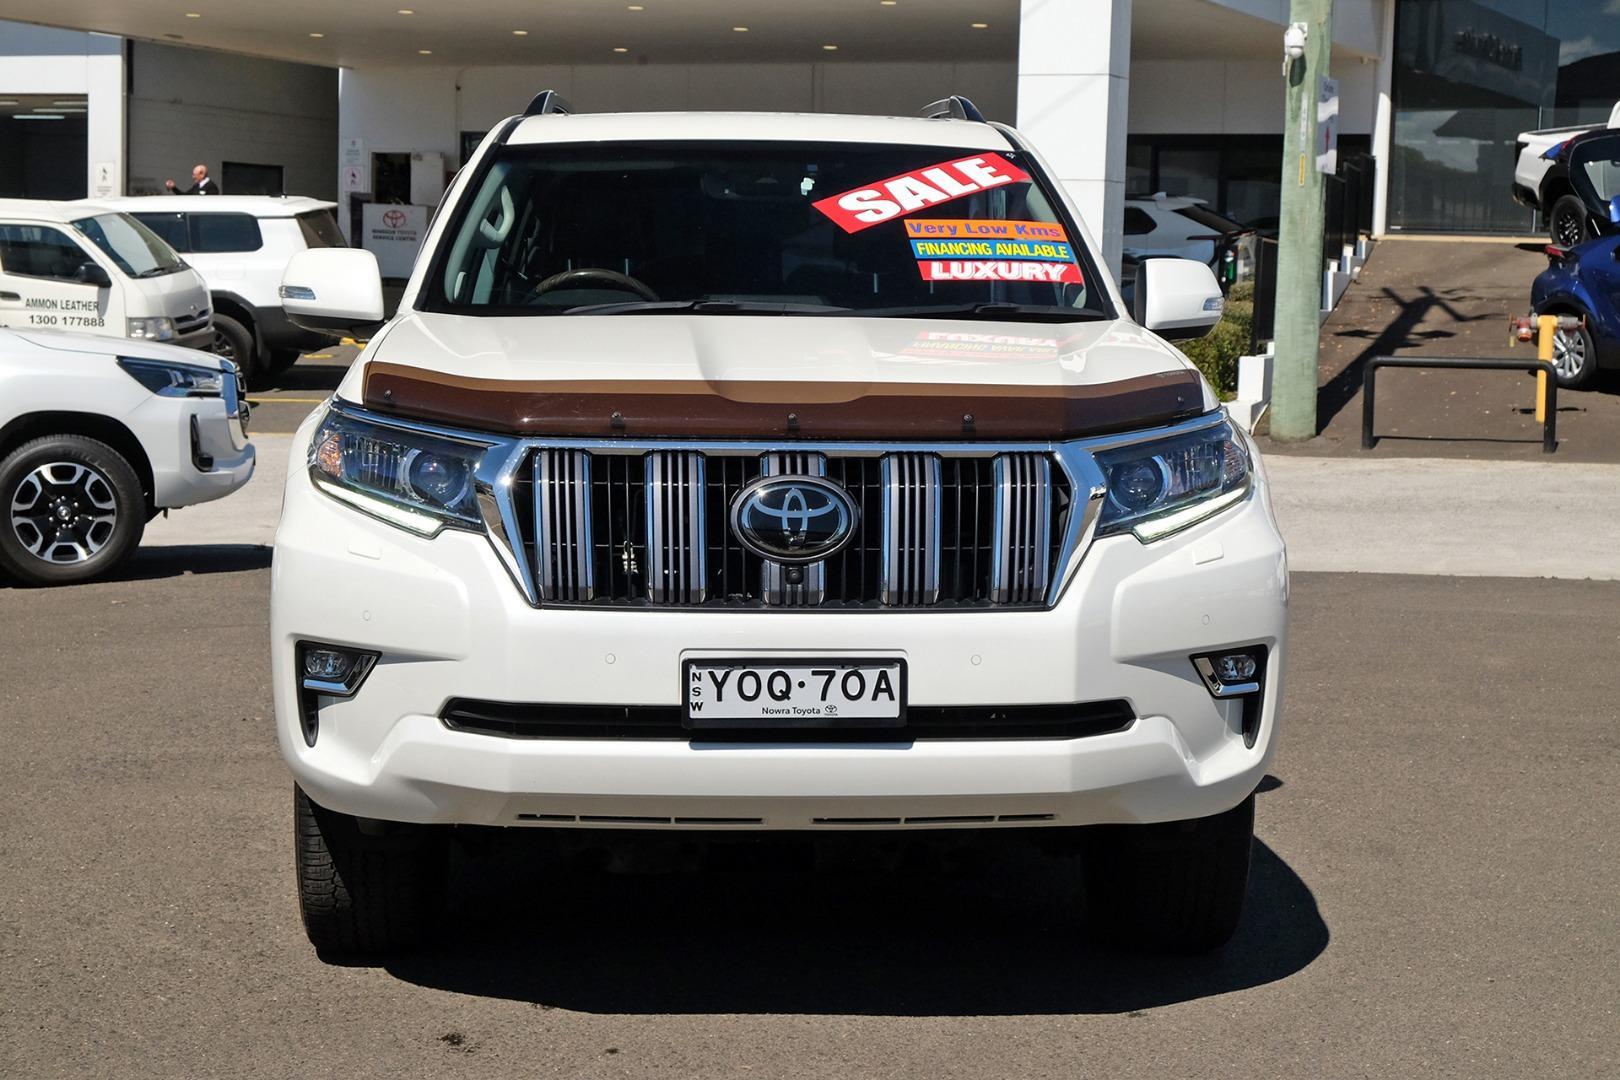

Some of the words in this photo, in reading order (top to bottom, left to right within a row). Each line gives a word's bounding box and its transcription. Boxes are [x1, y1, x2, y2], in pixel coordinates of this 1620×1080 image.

[837, 156, 1013, 223] SALE
[909, 222, 958, 236] Very
[965, 223, 1008, 235] Low
[1014, 223, 1062, 238] Kms
[916, 242, 992, 256] FINANCING
[995, 243, 1070, 259] AVAILABLE
[930, 260, 1068, 281] LUXURY
[25, 298, 58, 309] AMMON
[60, 300, 99, 311] LEATHER
[28, 315, 57, 325] 1300
[62, 316, 105, 327] 177888
[761, 706, 791, 715] Nowra
[792, 706, 821, 717] Toyota
